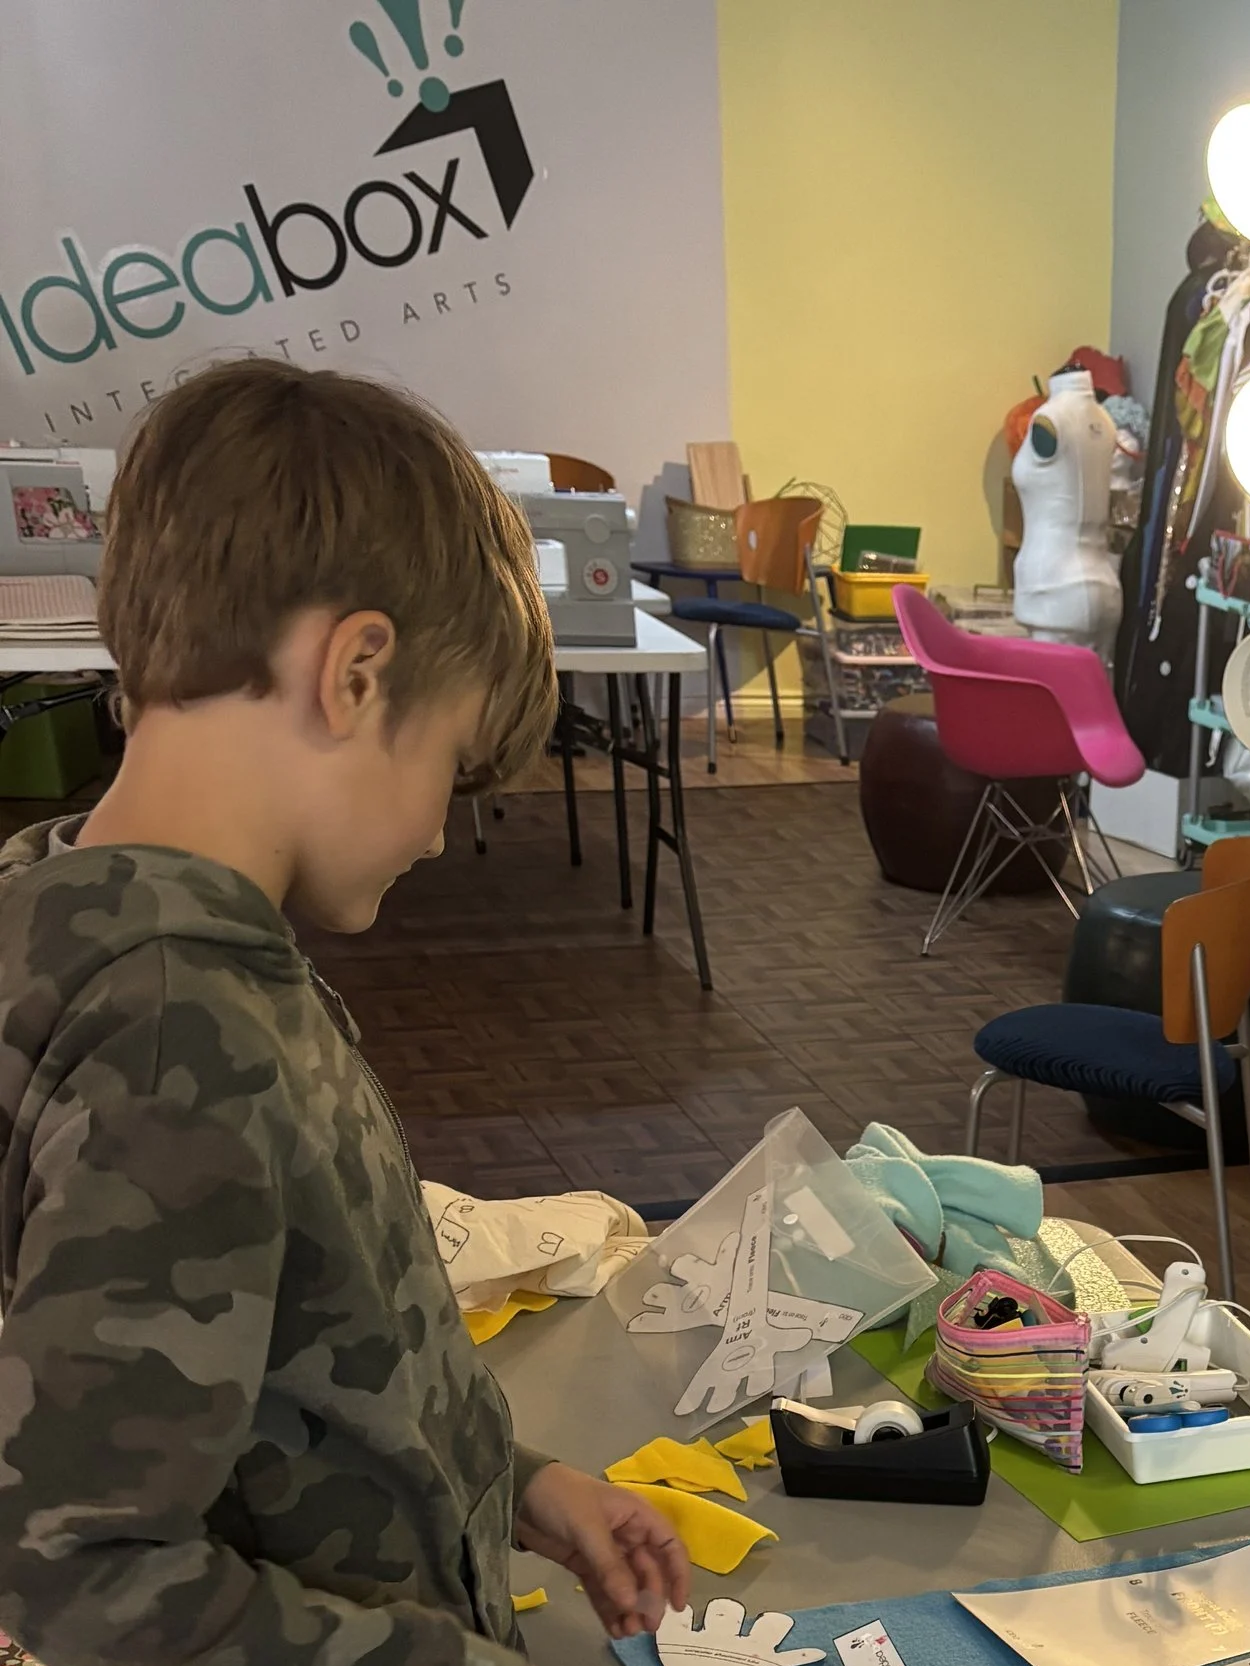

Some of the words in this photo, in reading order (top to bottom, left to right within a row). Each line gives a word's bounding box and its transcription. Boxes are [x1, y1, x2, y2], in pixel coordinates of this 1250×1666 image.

[402, 273, 512, 324] ARTS
[725, 1330, 753, 1344] Arm
[1126, 1612, 1157, 1635] FLEECE
